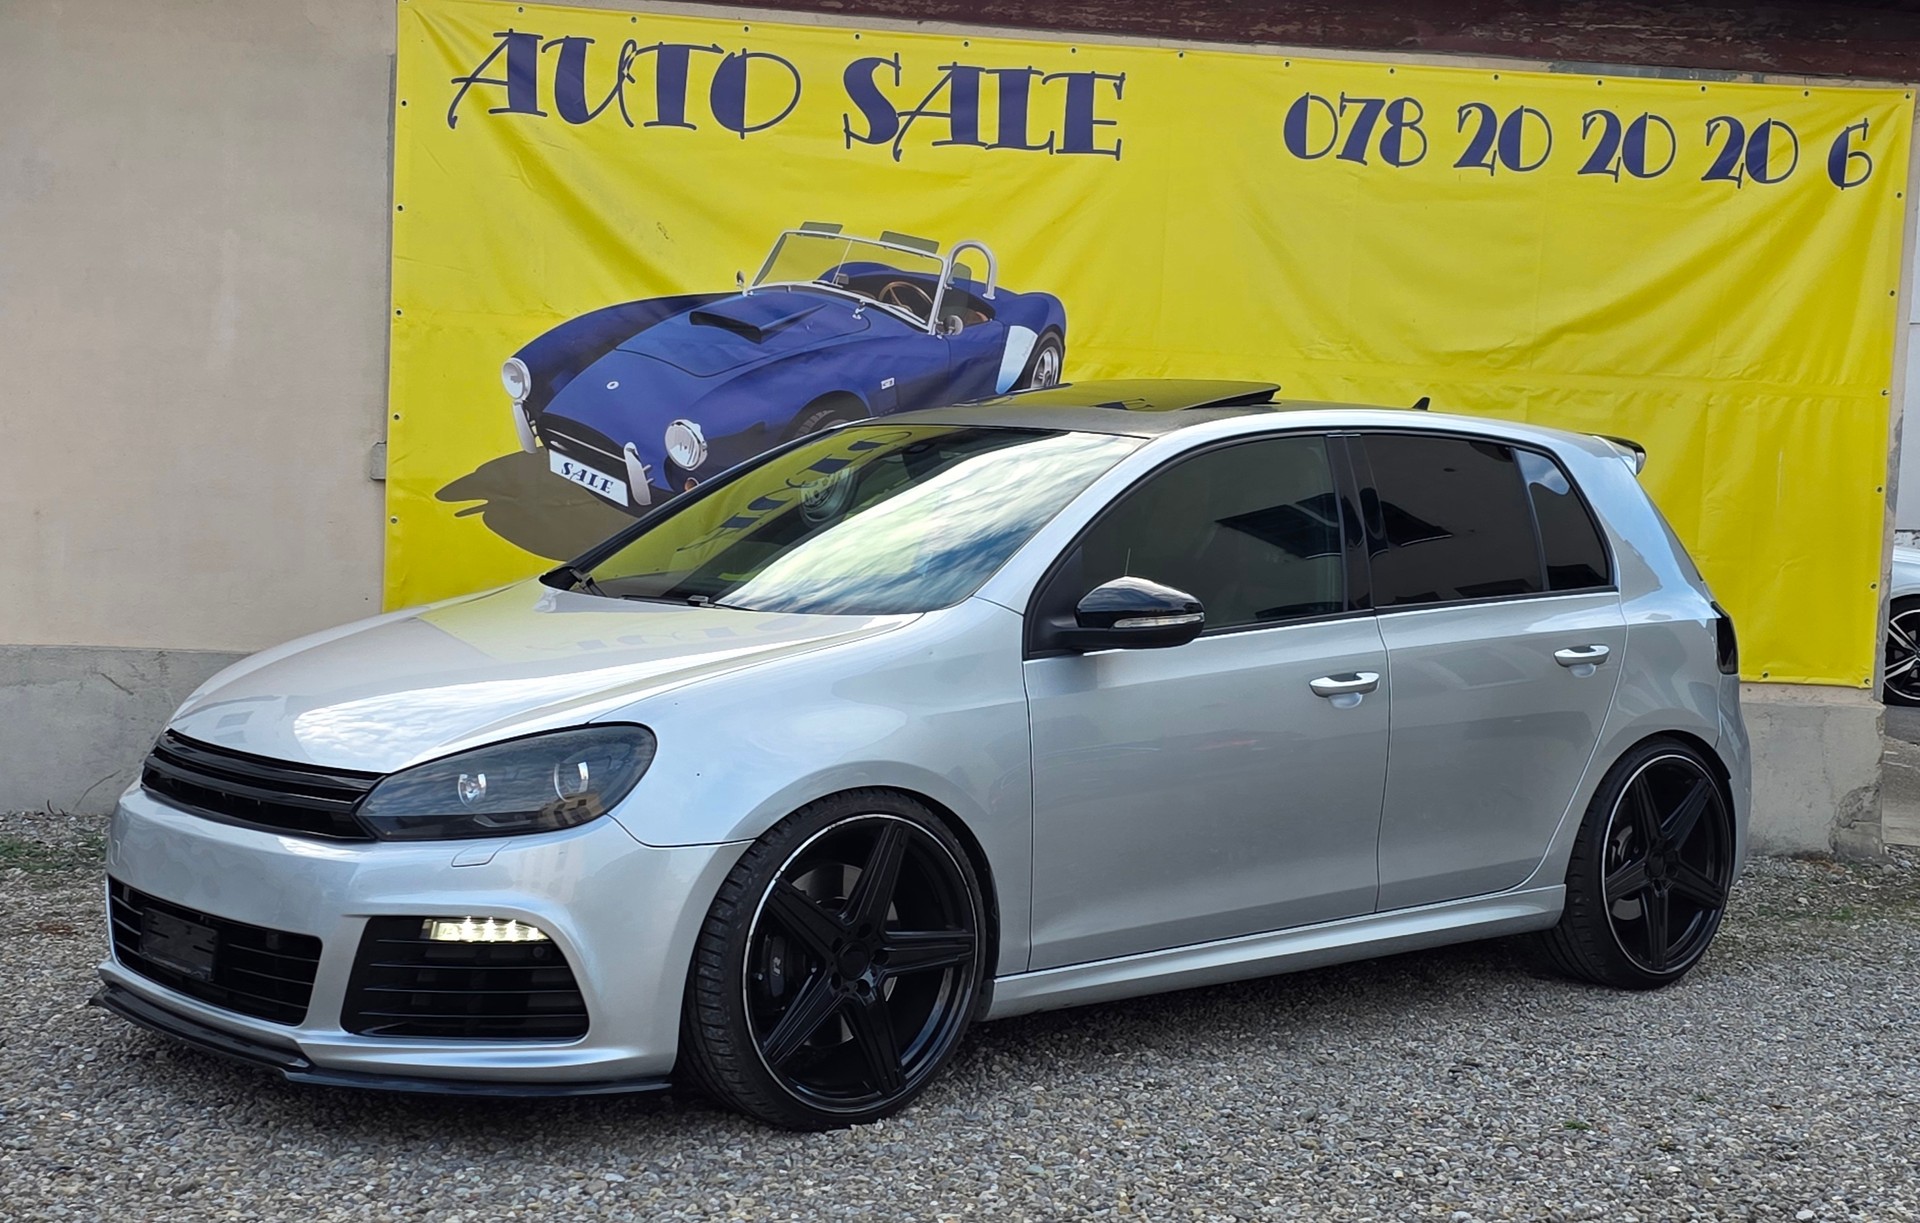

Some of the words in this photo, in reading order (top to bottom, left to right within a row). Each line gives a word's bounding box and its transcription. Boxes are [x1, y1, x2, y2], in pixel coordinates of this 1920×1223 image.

[447, 29, 801, 139] AUTO
[844, 53, 1125, 161] SALE
[1283, 92, 1428, 168] 078
[1453, 102, 1552, 176] 20
[1577, 109, 1676, 183] 20
[1701, 115, 1799, 189] 20
[1827, 118, 1873, 190] 6
[561, 462, 614, 494] SALE
